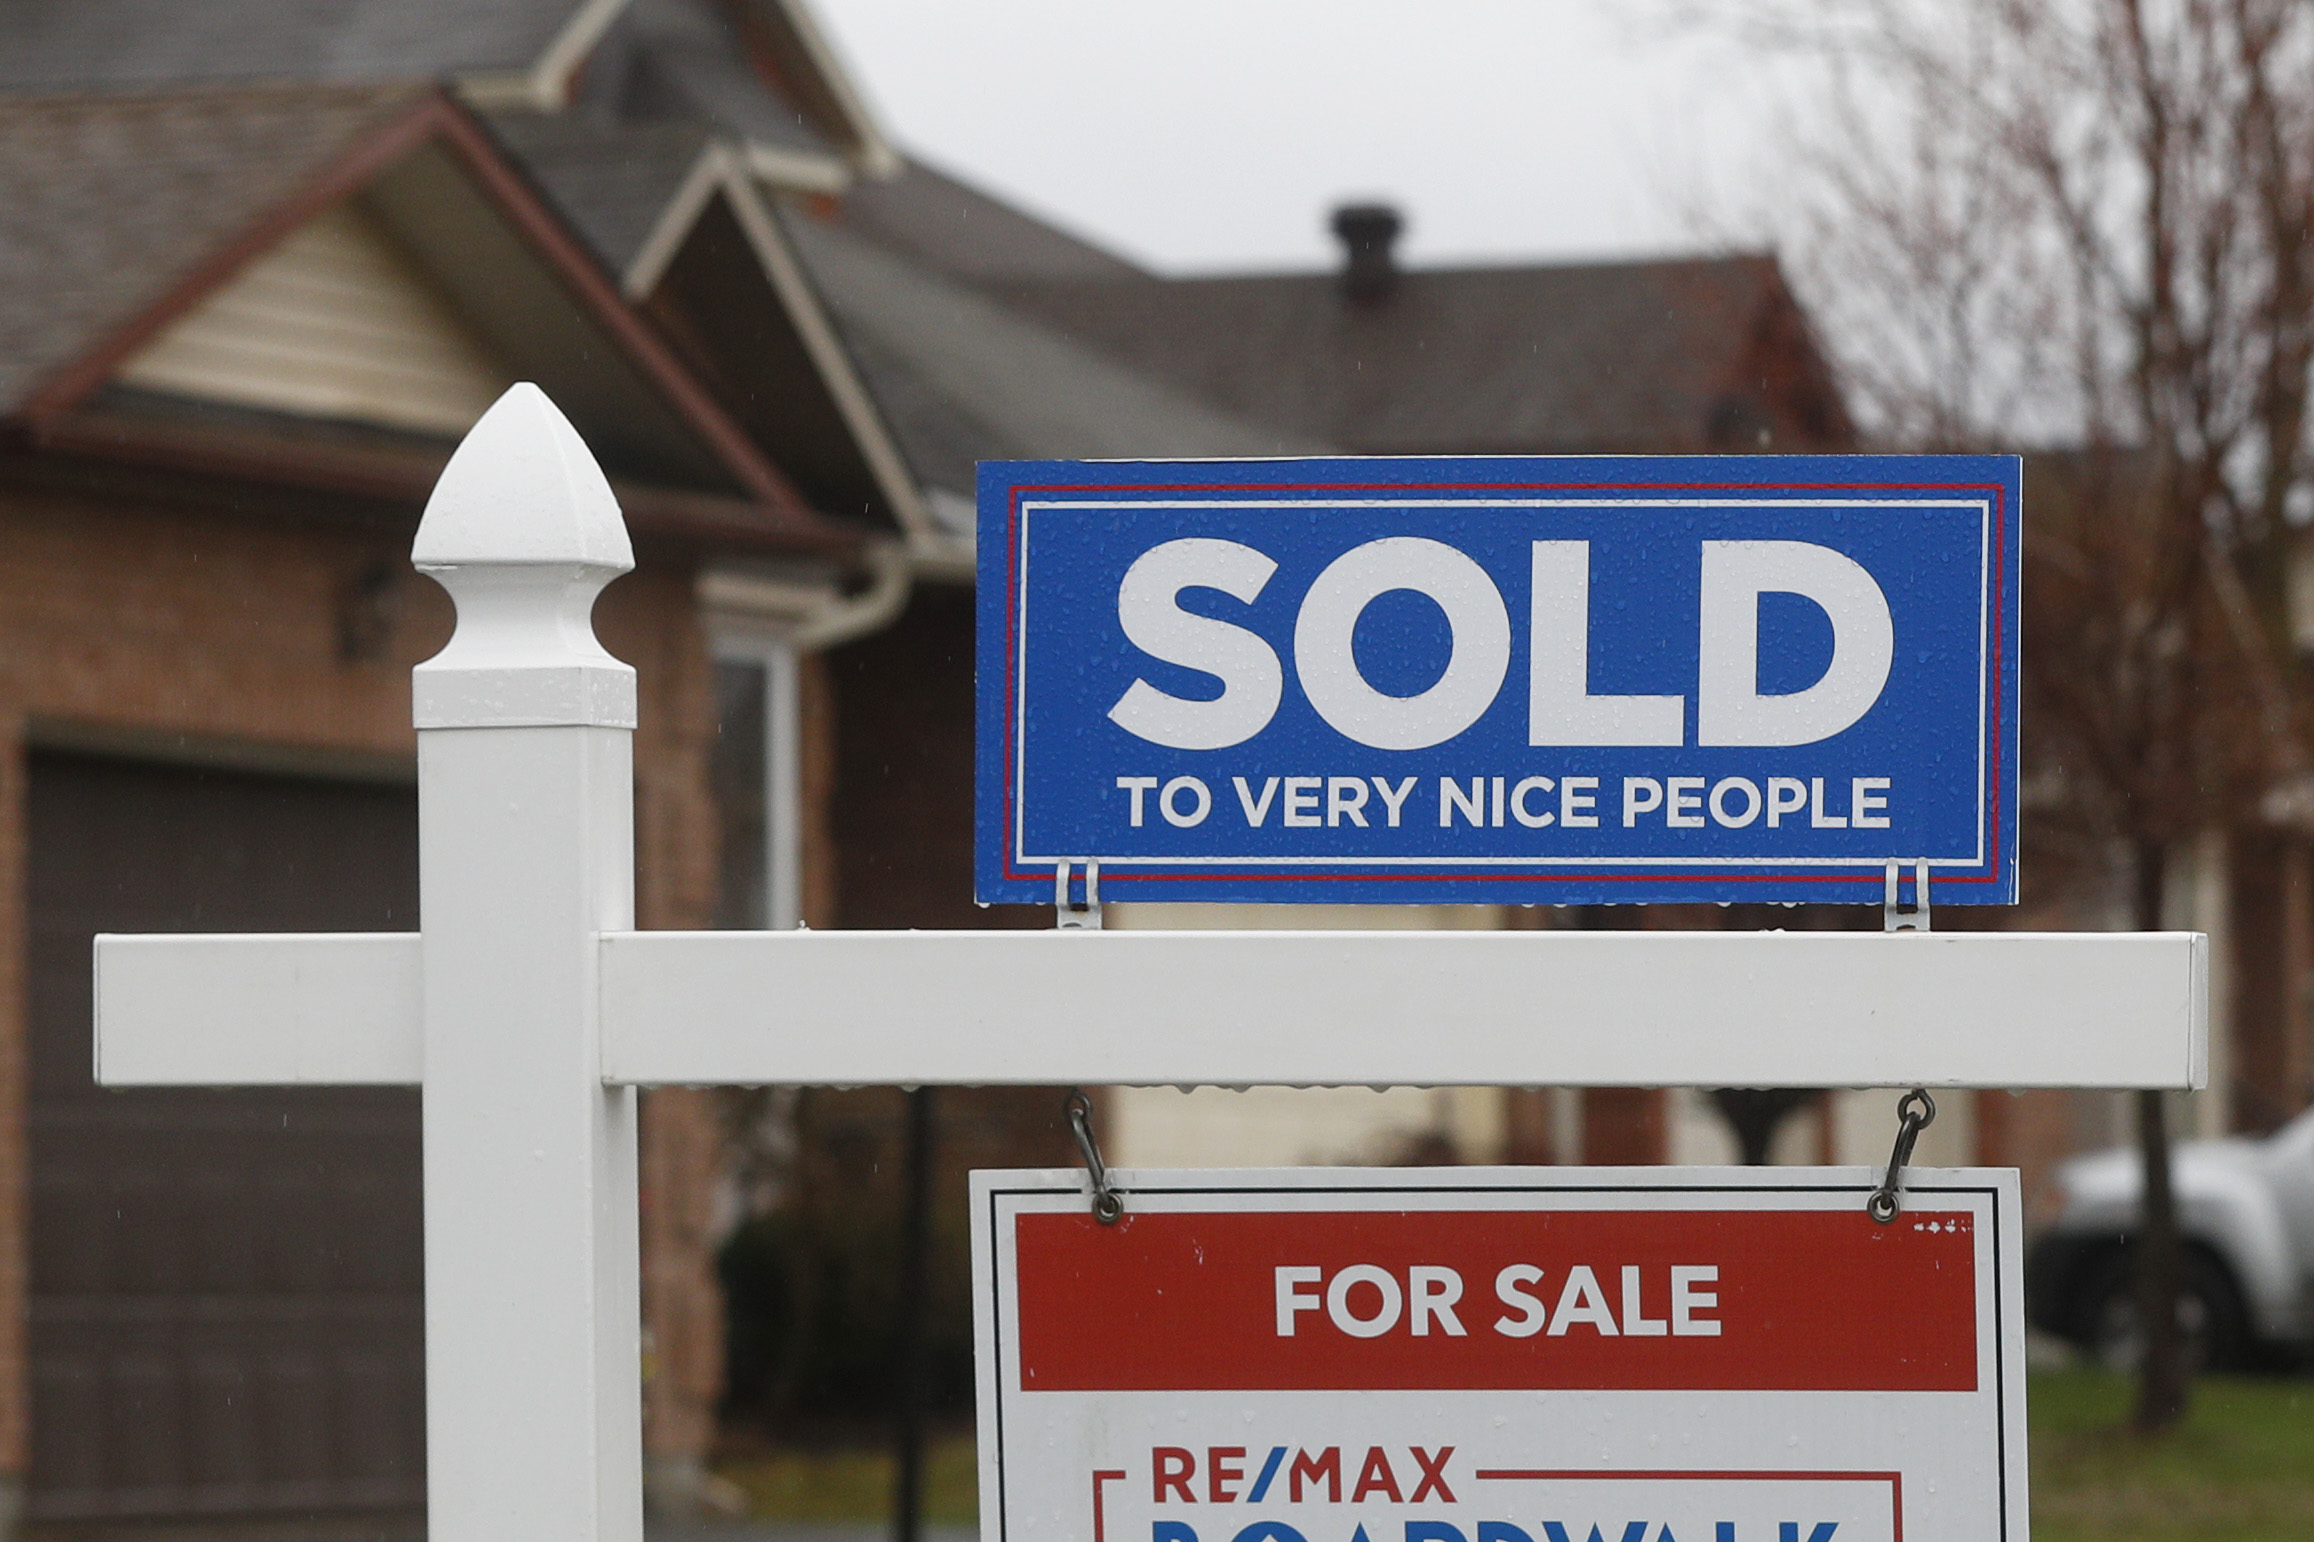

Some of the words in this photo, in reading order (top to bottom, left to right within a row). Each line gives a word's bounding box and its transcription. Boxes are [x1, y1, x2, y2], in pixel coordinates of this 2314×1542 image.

[1107, 536, 1894, 751] SOLD
[1116, 775, 1212, 828] TO
[1231, 775, 1418, 828] VERY
[1439, 775, 1599, 828] NICE
[1622, 776, 1891, 829] PEOPLE
[1273, 1263, 1468, 1338] FOR
[1493, 1263, 1723, 1338] SALE
[1152, 1446, 1458, 1503] RE/MAX
